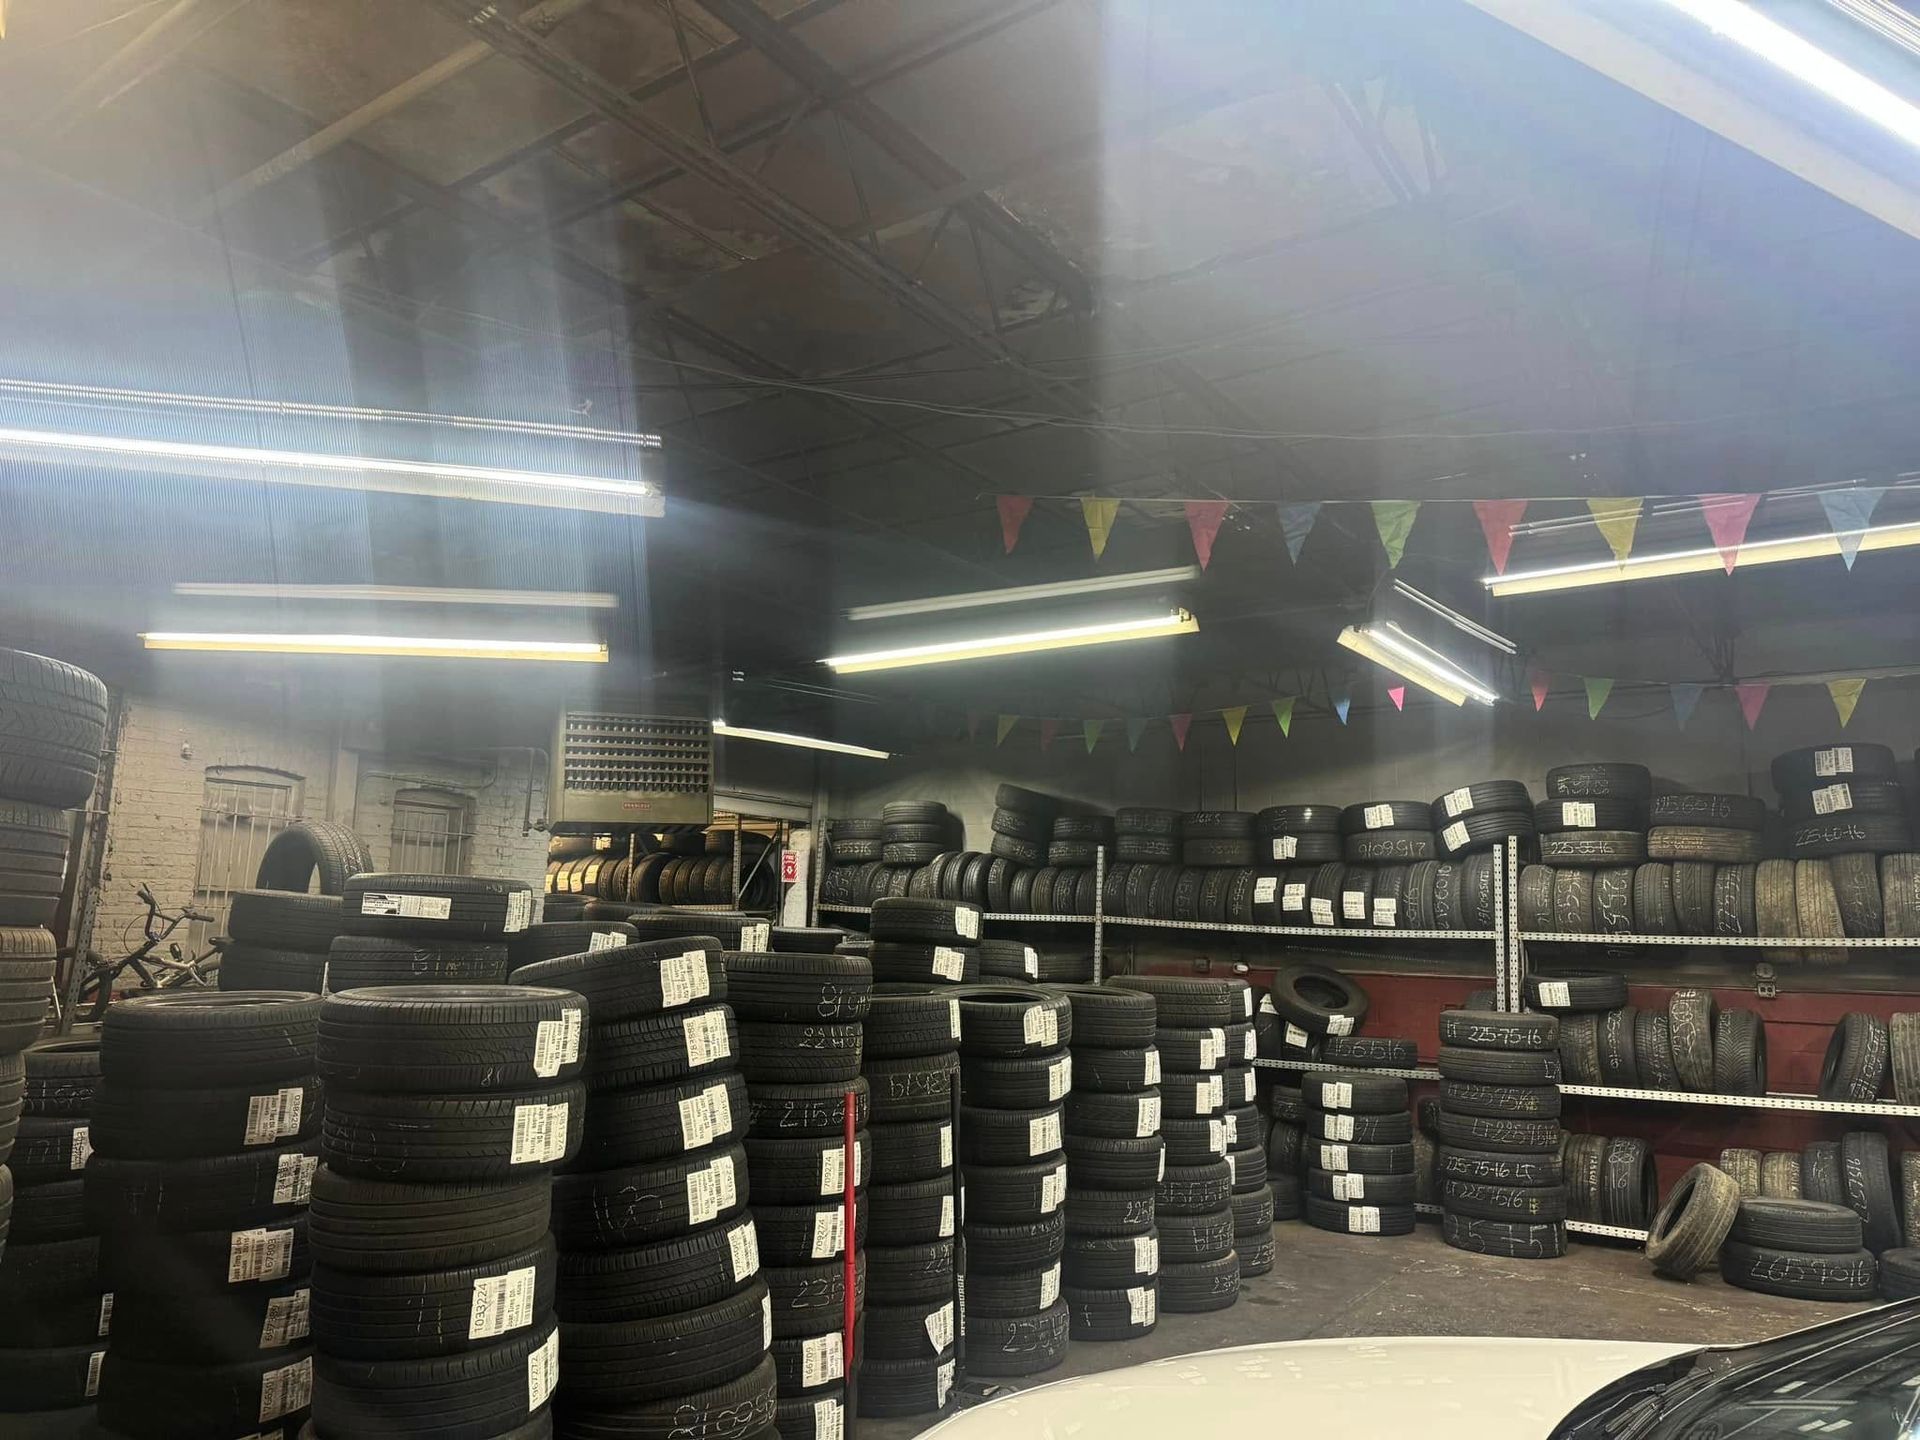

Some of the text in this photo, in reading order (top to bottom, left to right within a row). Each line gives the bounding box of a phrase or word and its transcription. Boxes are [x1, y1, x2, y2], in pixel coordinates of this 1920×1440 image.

[1467, 1026, 1542, 1045] 225-75-16
[291, 1094, 301, 1129] 038420
[823, 1156, 832, 1190] 709274
[815, 1219, 825, 1251] 709274
[475, 1283, 488, 1332] 1033224
[956, 1274, 965, 1337] PITTSBURGH
[806, 1346, 814, 1379] 166709
